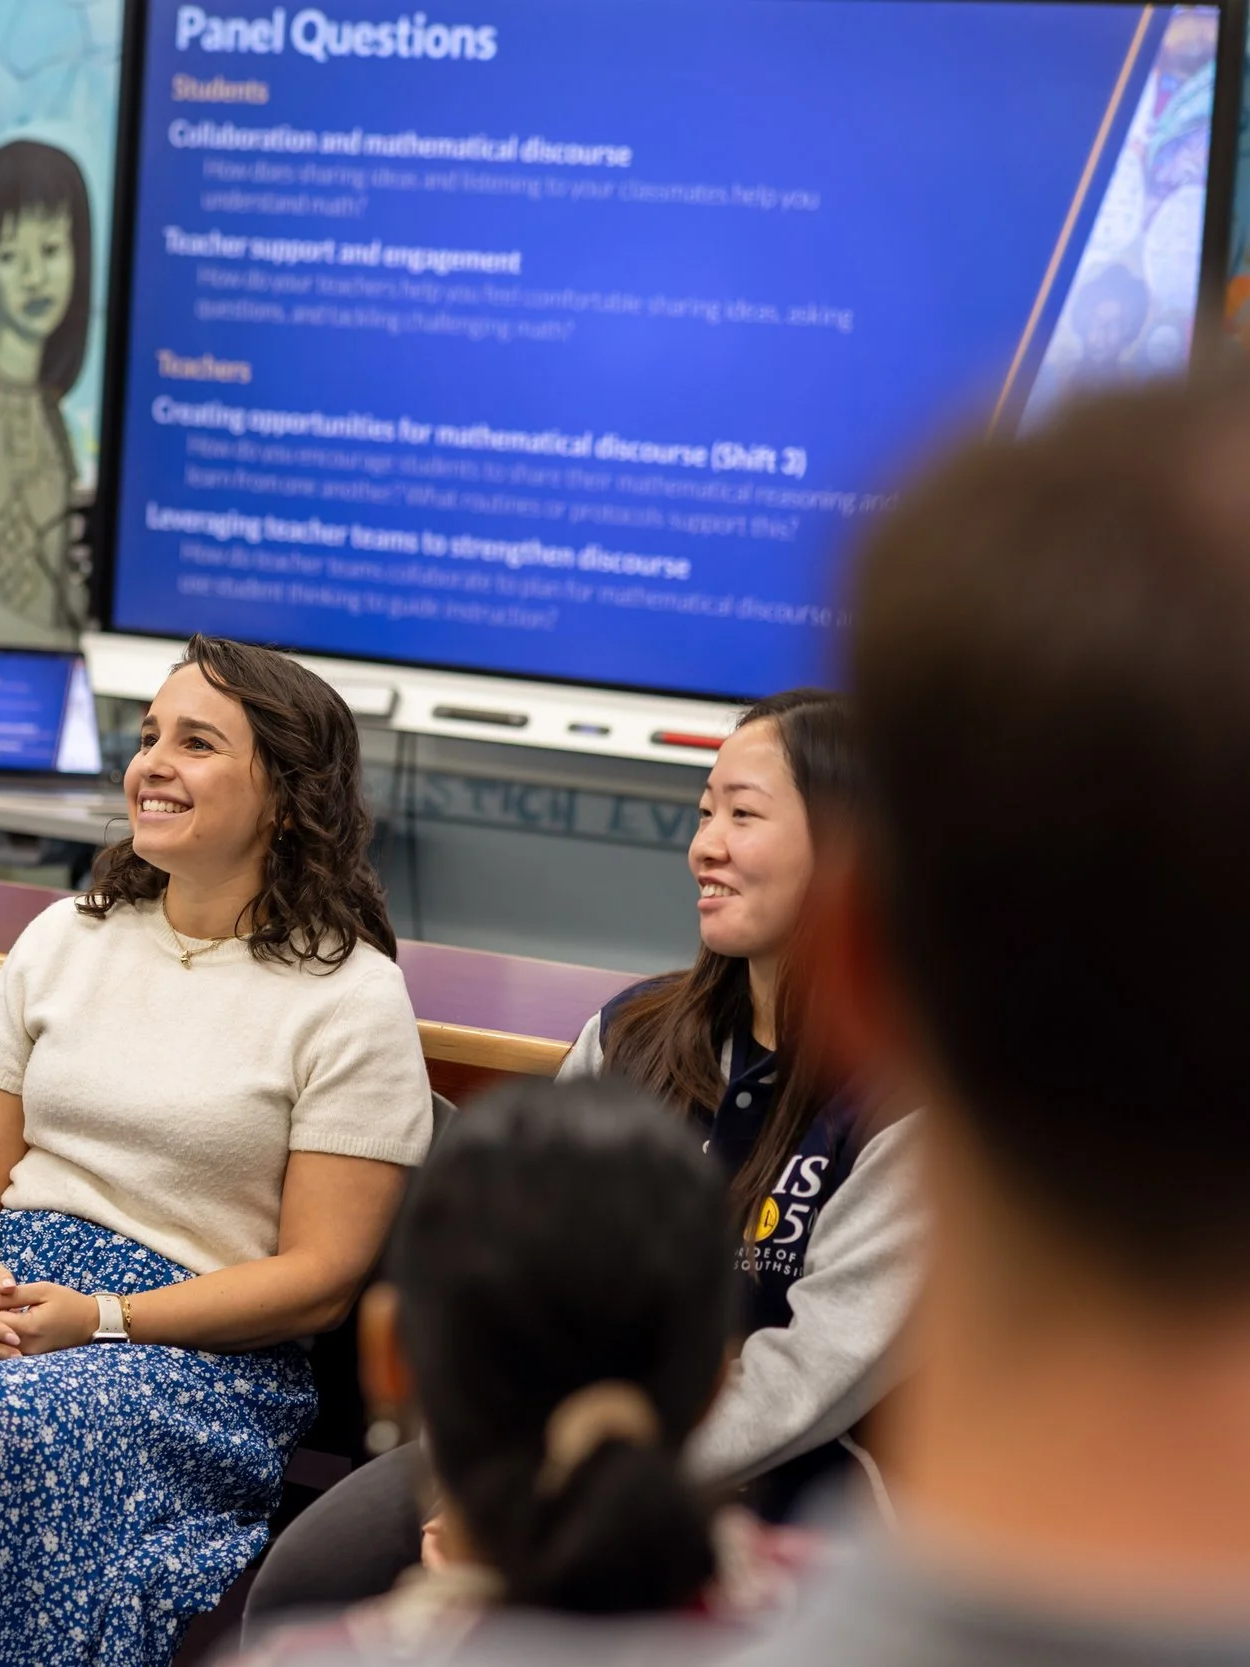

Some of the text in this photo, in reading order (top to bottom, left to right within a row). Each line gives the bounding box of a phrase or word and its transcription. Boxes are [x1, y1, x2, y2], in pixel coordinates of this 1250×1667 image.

[176, 5, 498, 61] Panel Questions
[171, 74, 269, 104] Students
[168, 119, 633, 167] Collaboration and mathematical discourse
[162, 226, 521, 275] Teacher support and engagement
[156, 349, 252, 384] Teachers
[152, 395, 807, 478] Creating opportunities for mathematical discourse (Shift 3)
[146, 502, 692, 580] Leveraging teacher teams to strengthen discourse
[776, 1249, 796, 1263] OF
